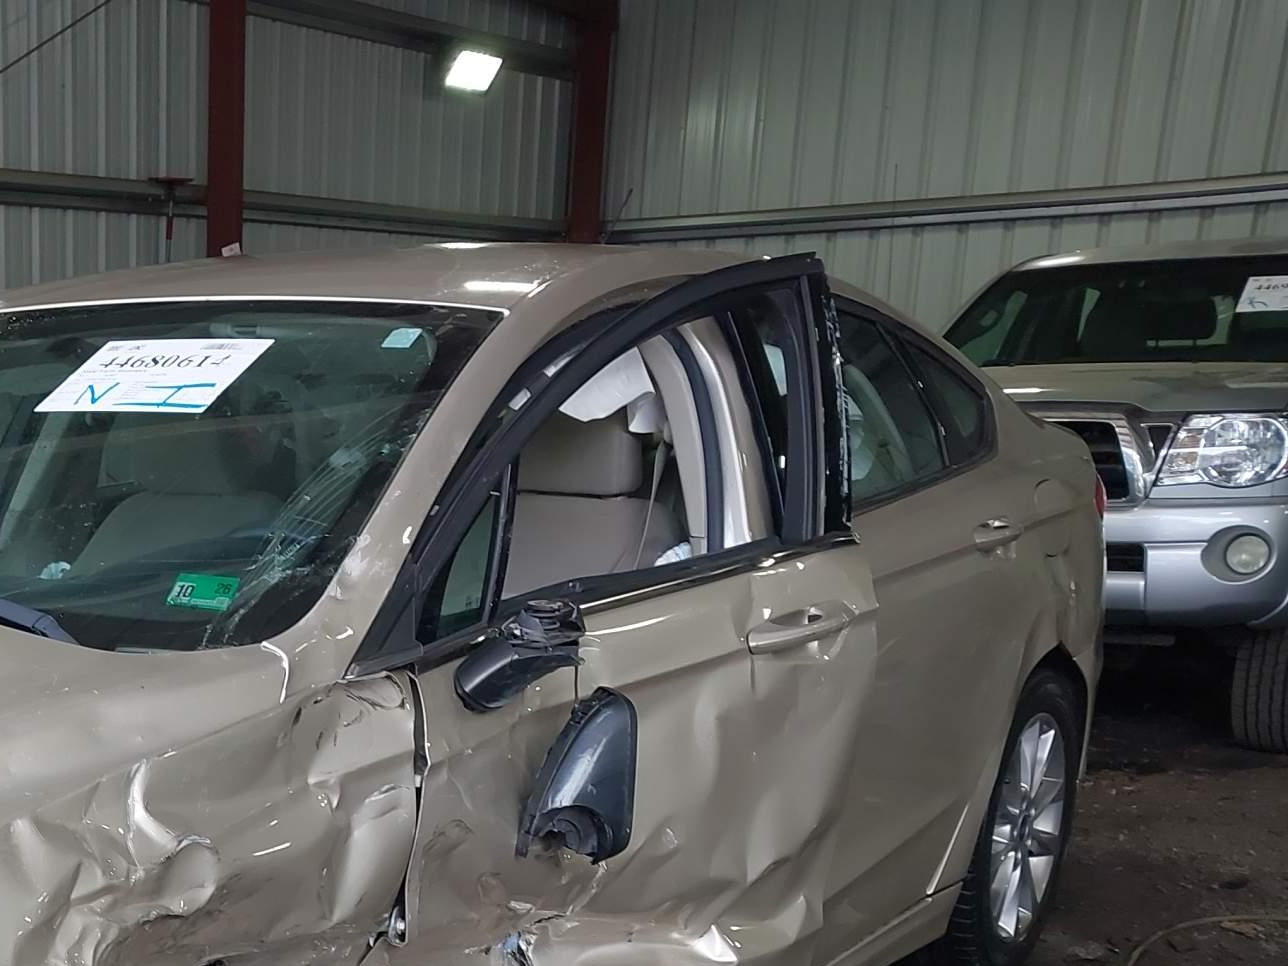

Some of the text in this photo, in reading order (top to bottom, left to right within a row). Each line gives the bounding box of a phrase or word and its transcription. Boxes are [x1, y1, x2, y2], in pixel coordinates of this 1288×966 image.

[99, 352, 232, 369] 44680614
[73, 381, 122, 406] N
[176, 583, 233, 598] 10 26
